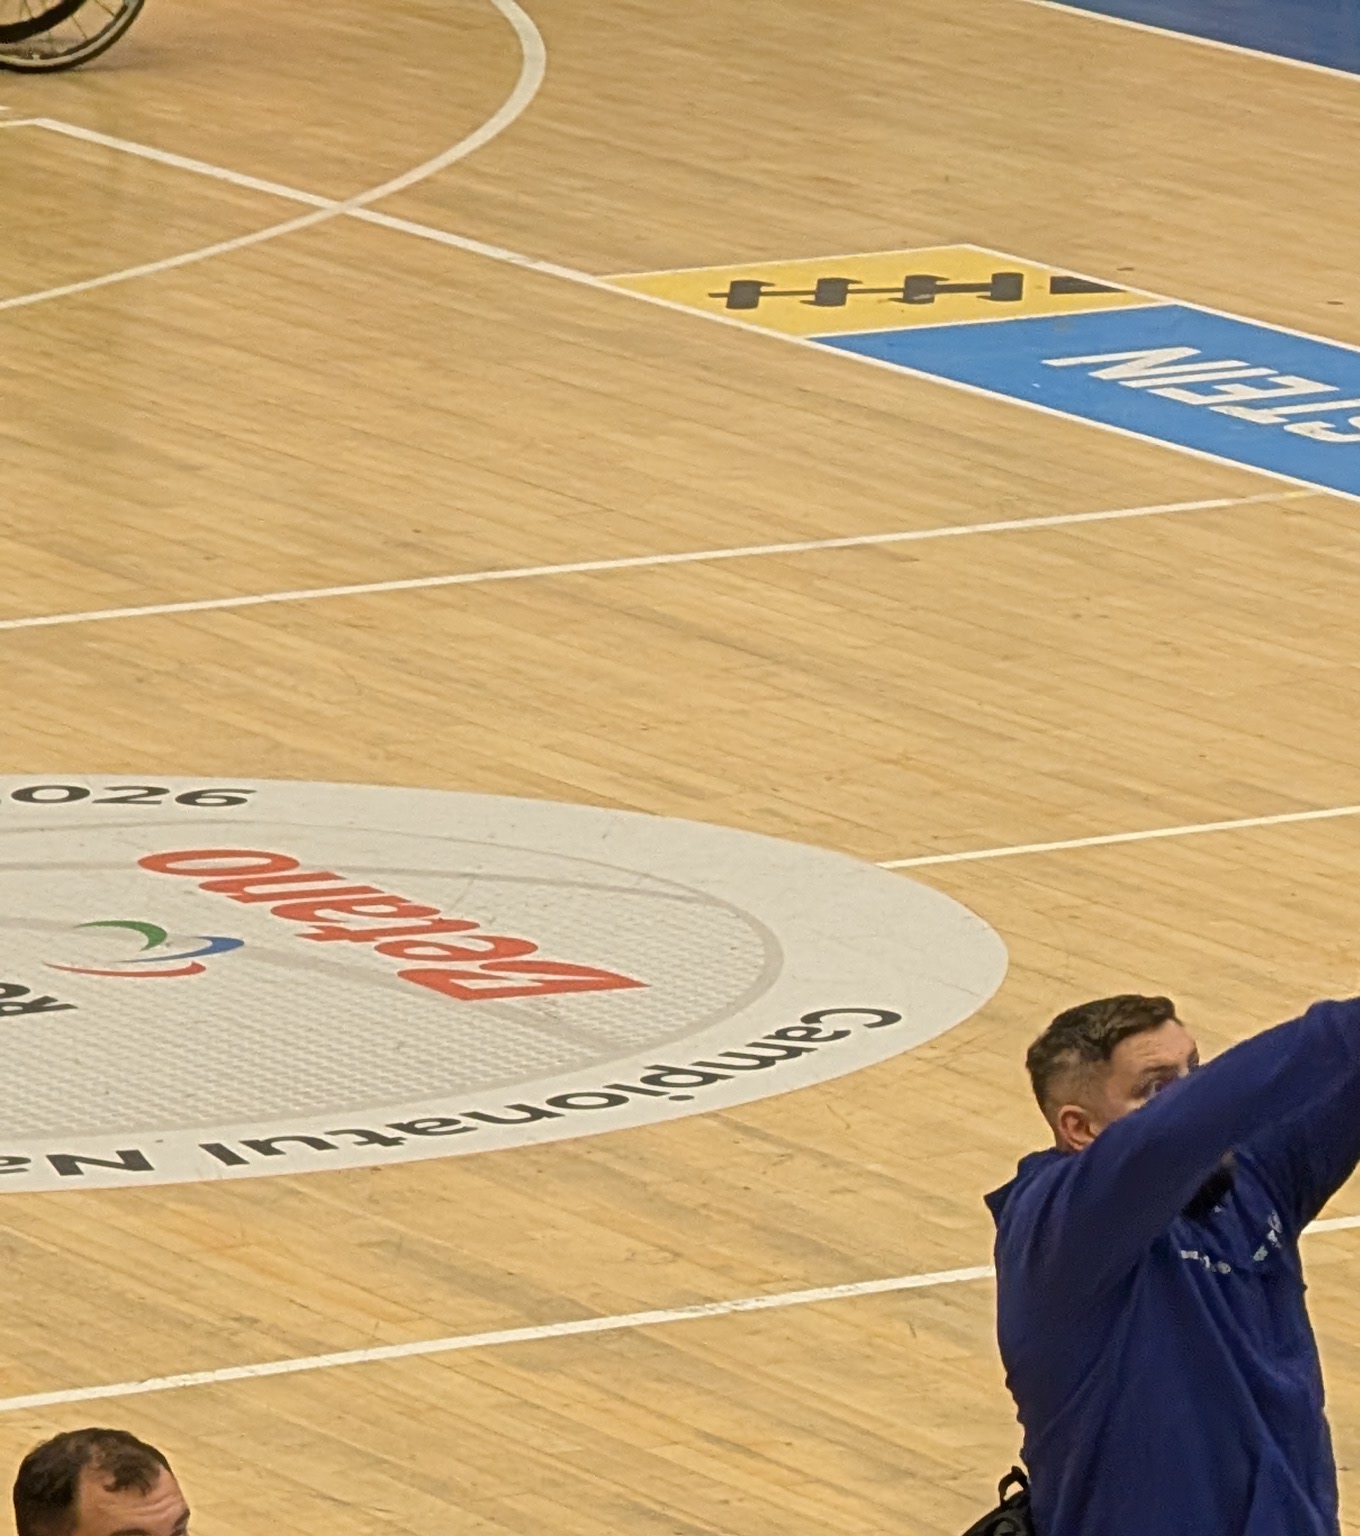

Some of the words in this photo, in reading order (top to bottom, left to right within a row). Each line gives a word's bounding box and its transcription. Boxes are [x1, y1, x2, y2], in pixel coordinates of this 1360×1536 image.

[0, 785, 257, 807] 026
[138, 848, 652, 1001] Betano
[200, 1005, 903, 1169] Campionatul
